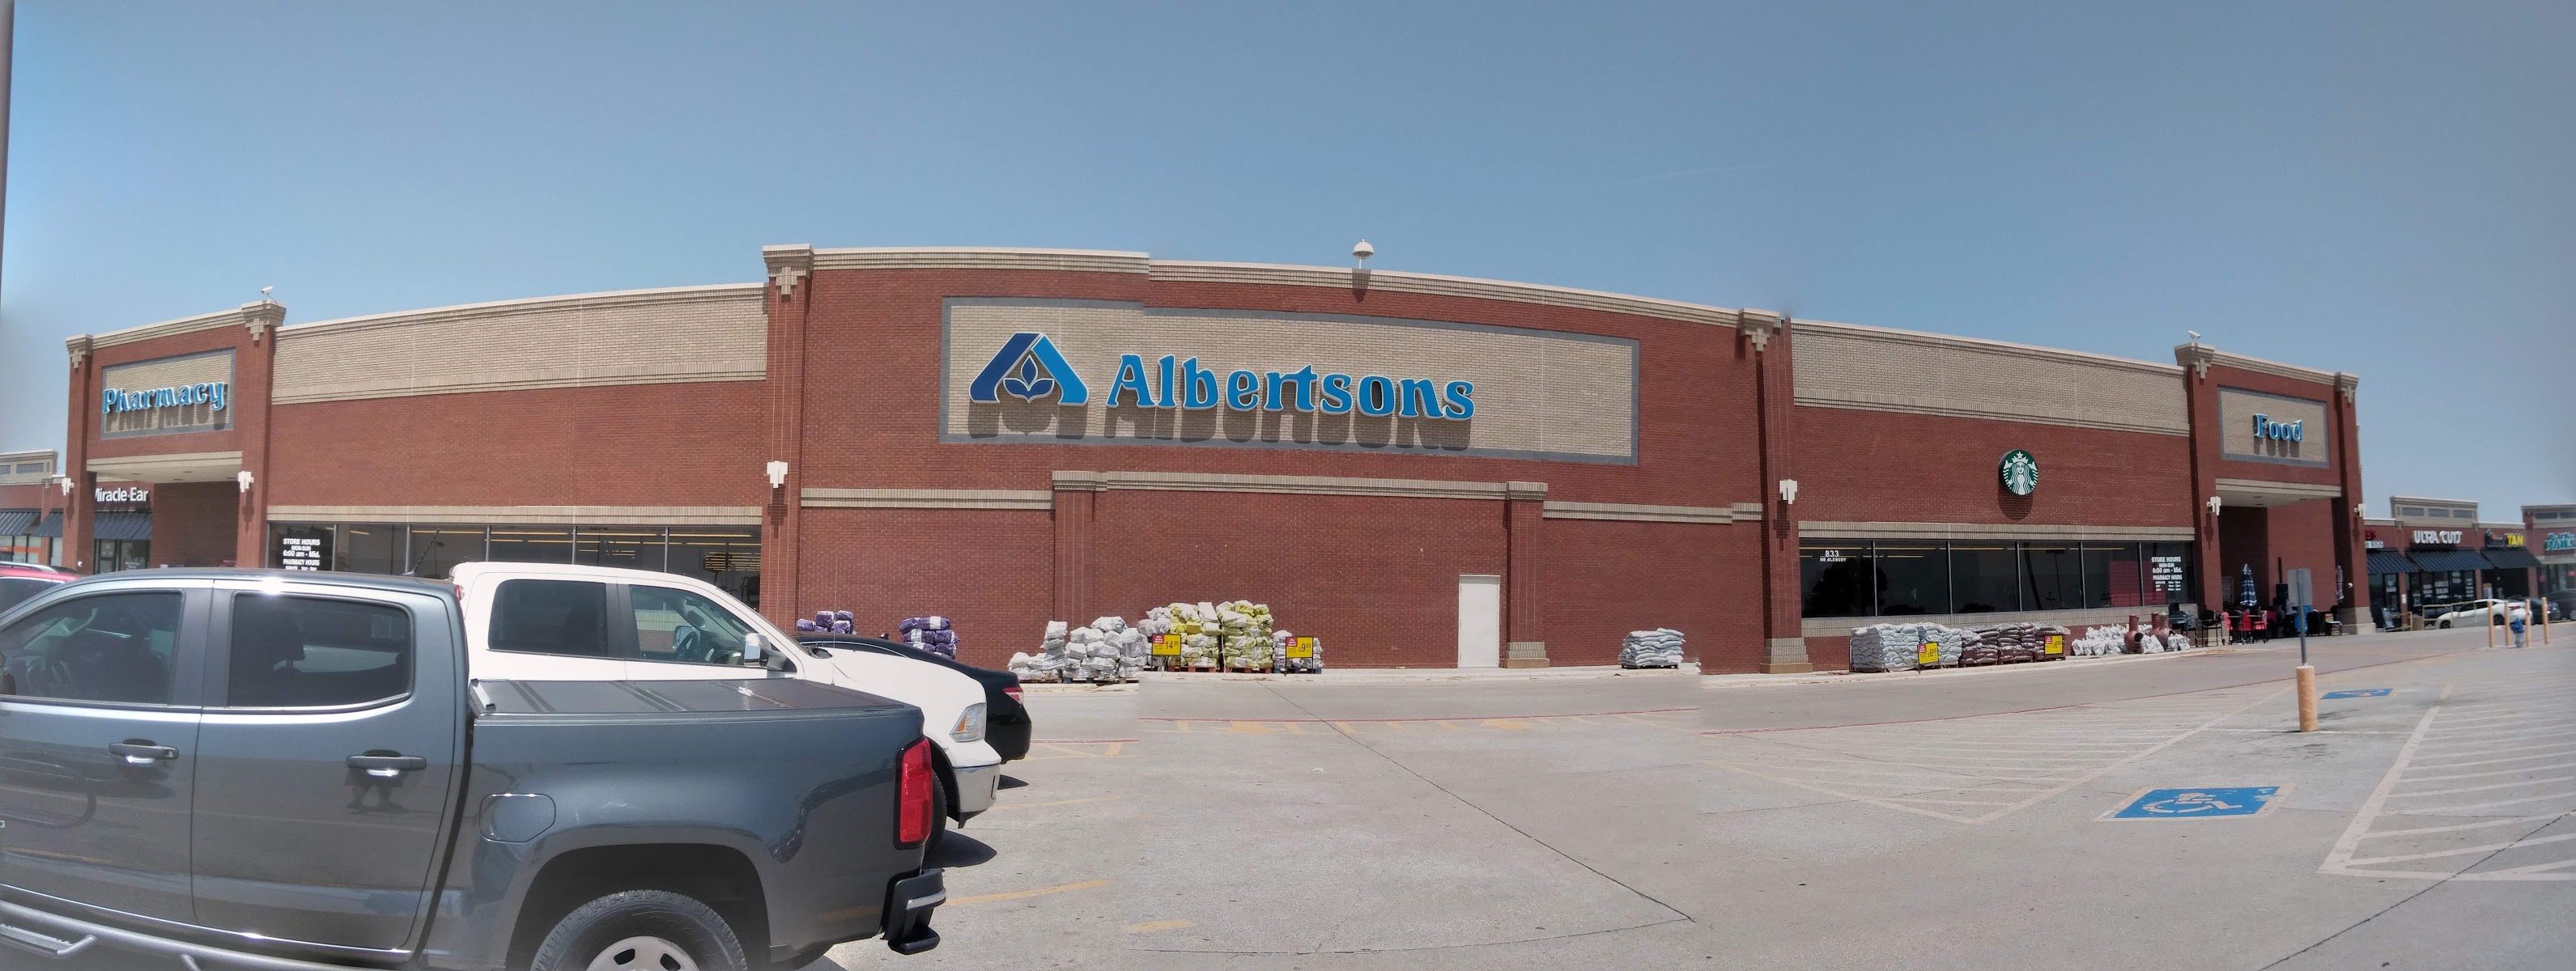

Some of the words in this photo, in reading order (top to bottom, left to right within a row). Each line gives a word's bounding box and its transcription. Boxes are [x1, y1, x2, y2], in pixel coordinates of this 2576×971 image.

[102, 381, 227, 413] Pharmacy
[1106, 352, 1475, 421] Albertsons
[2253, 413, 2303, 442] Food
[2412, 530, 2438, 544] ULTRA
[2439, 530, 2463, 544] CUTS
[2506, 534, 2524, 546] TAN
[1825, 549, 1839, 558] 833
